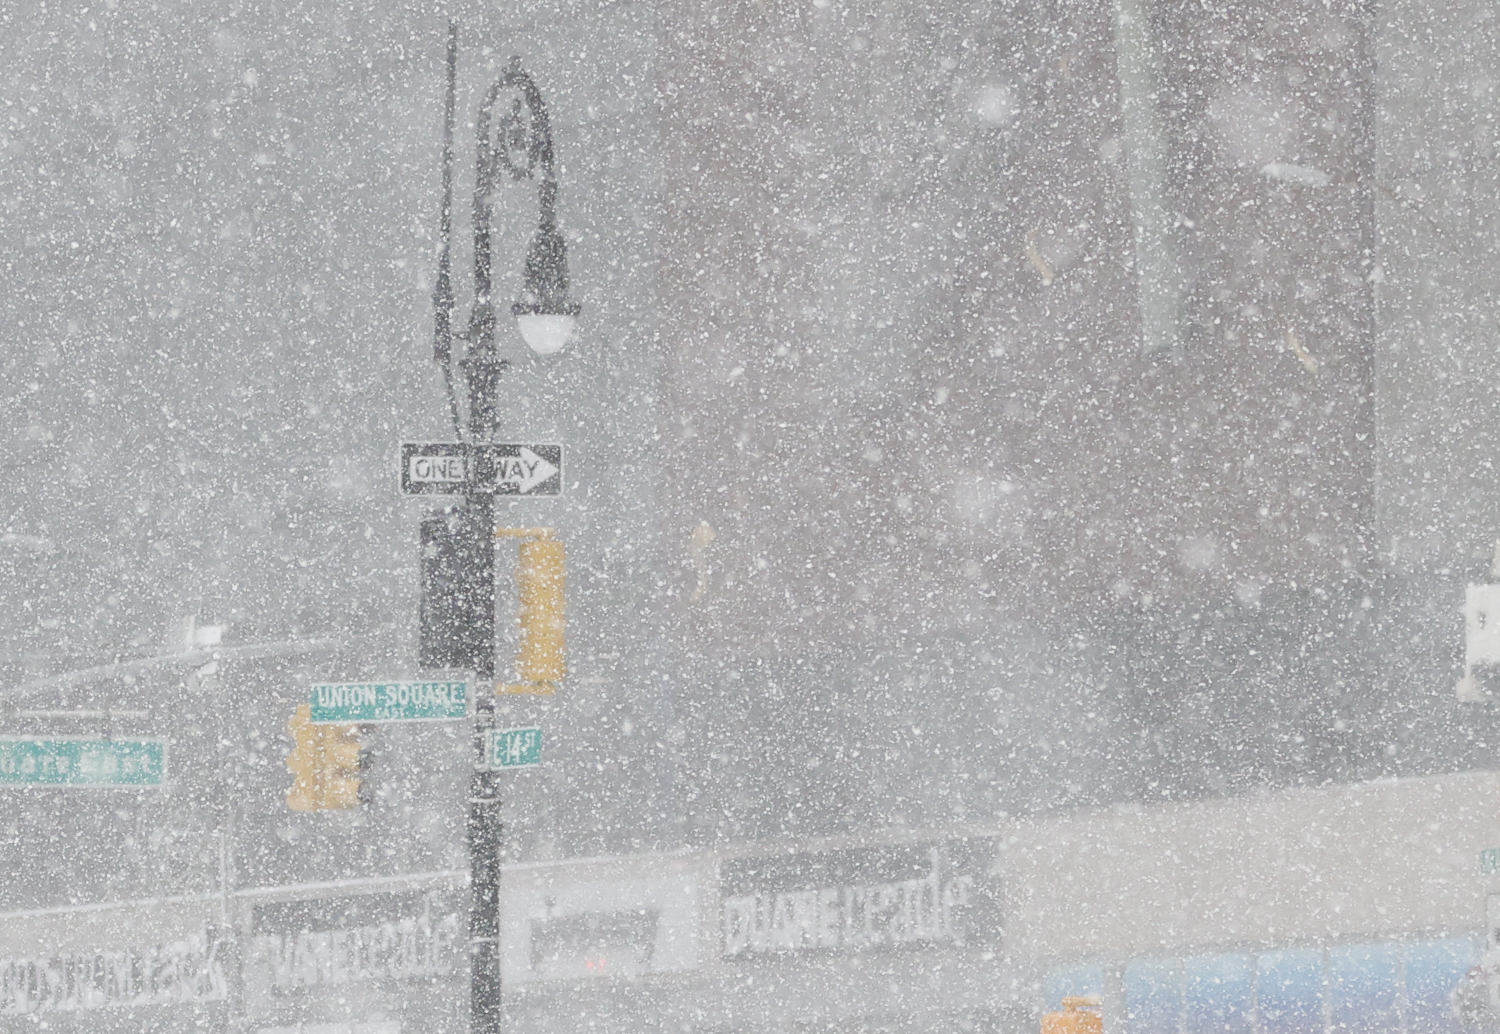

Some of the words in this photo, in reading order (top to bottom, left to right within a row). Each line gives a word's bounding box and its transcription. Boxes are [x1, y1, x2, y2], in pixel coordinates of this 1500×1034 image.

[415, 459, 462, 479] ONE
[493, 460, 539, 480] WAY
[317, 685, 376, 708] UNION
[385, 684, 463, 706] SQUARE
[375, 706, 405, 719] EAST
[493, 735, 502, 764] E
[506, 734, 522, 764] 14
[81, 752, 151, 774] ast
